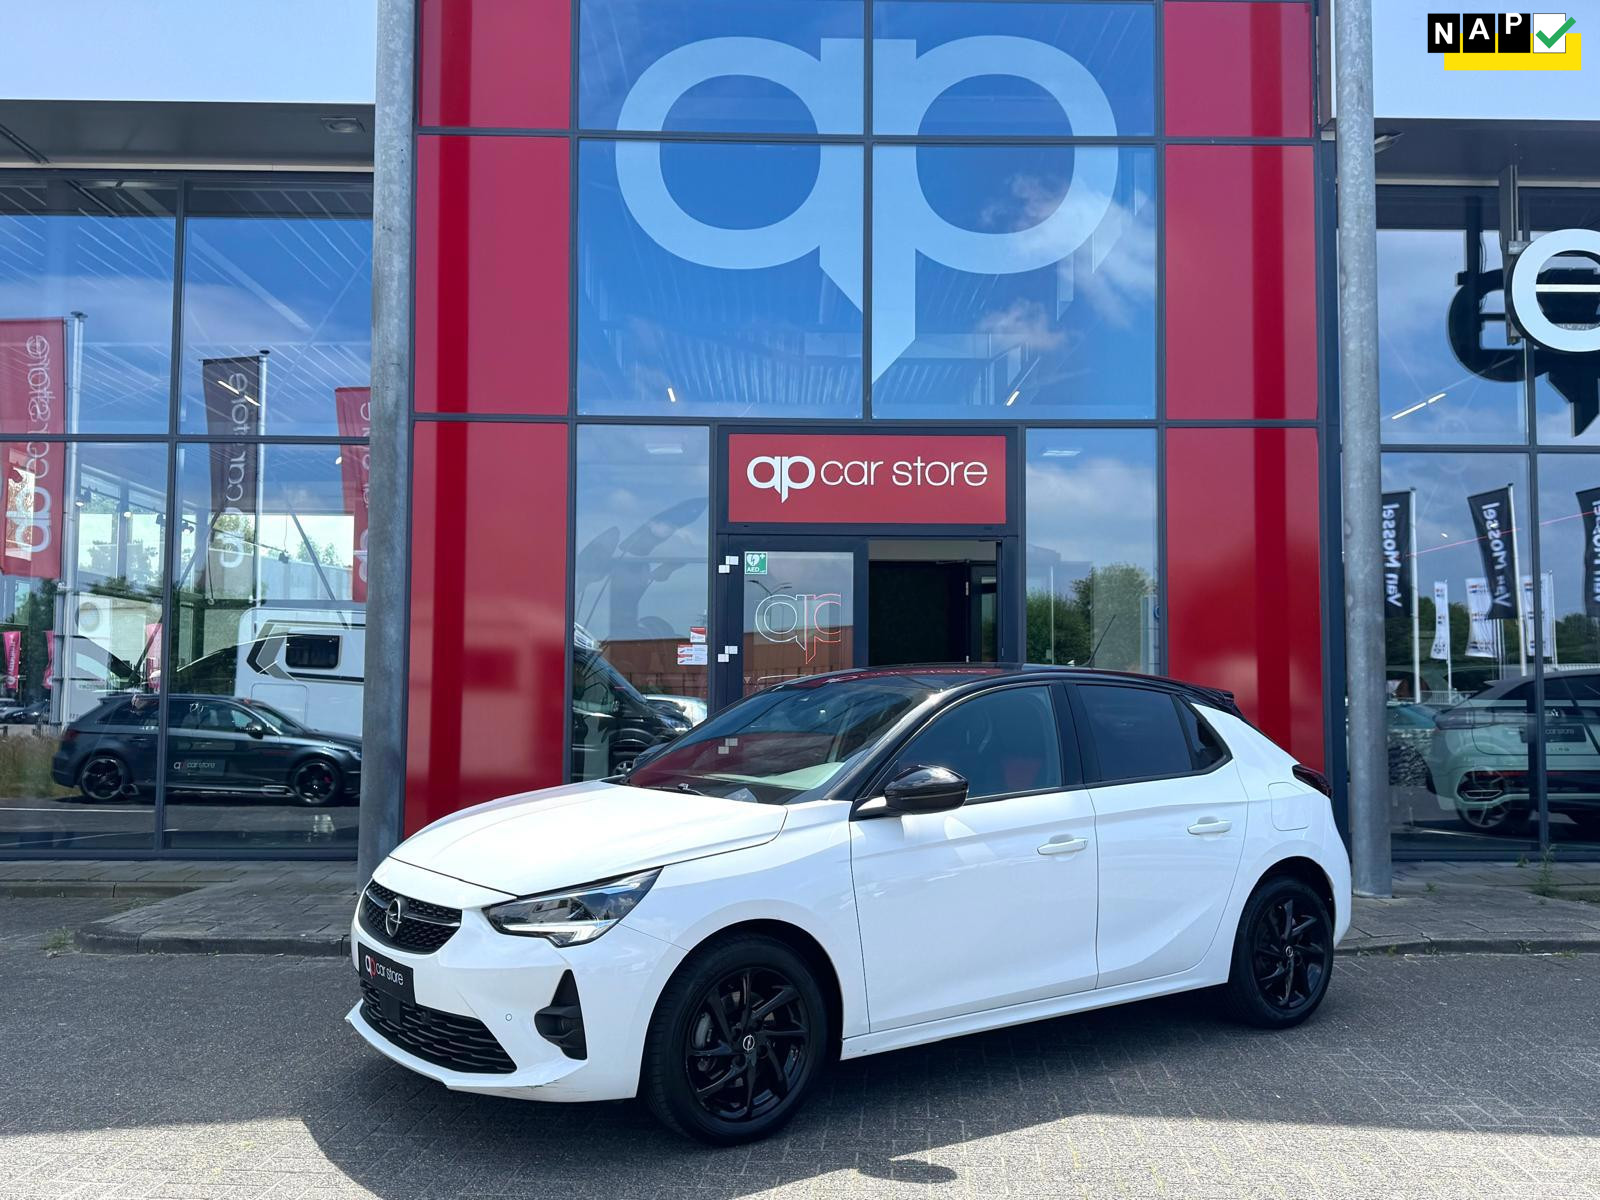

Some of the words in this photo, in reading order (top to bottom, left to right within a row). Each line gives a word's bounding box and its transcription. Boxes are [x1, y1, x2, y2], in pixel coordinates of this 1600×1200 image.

[746, 455, 816, 503] ap
[820, 459, 884, 487] car
[892, 455, 988, 487] store
